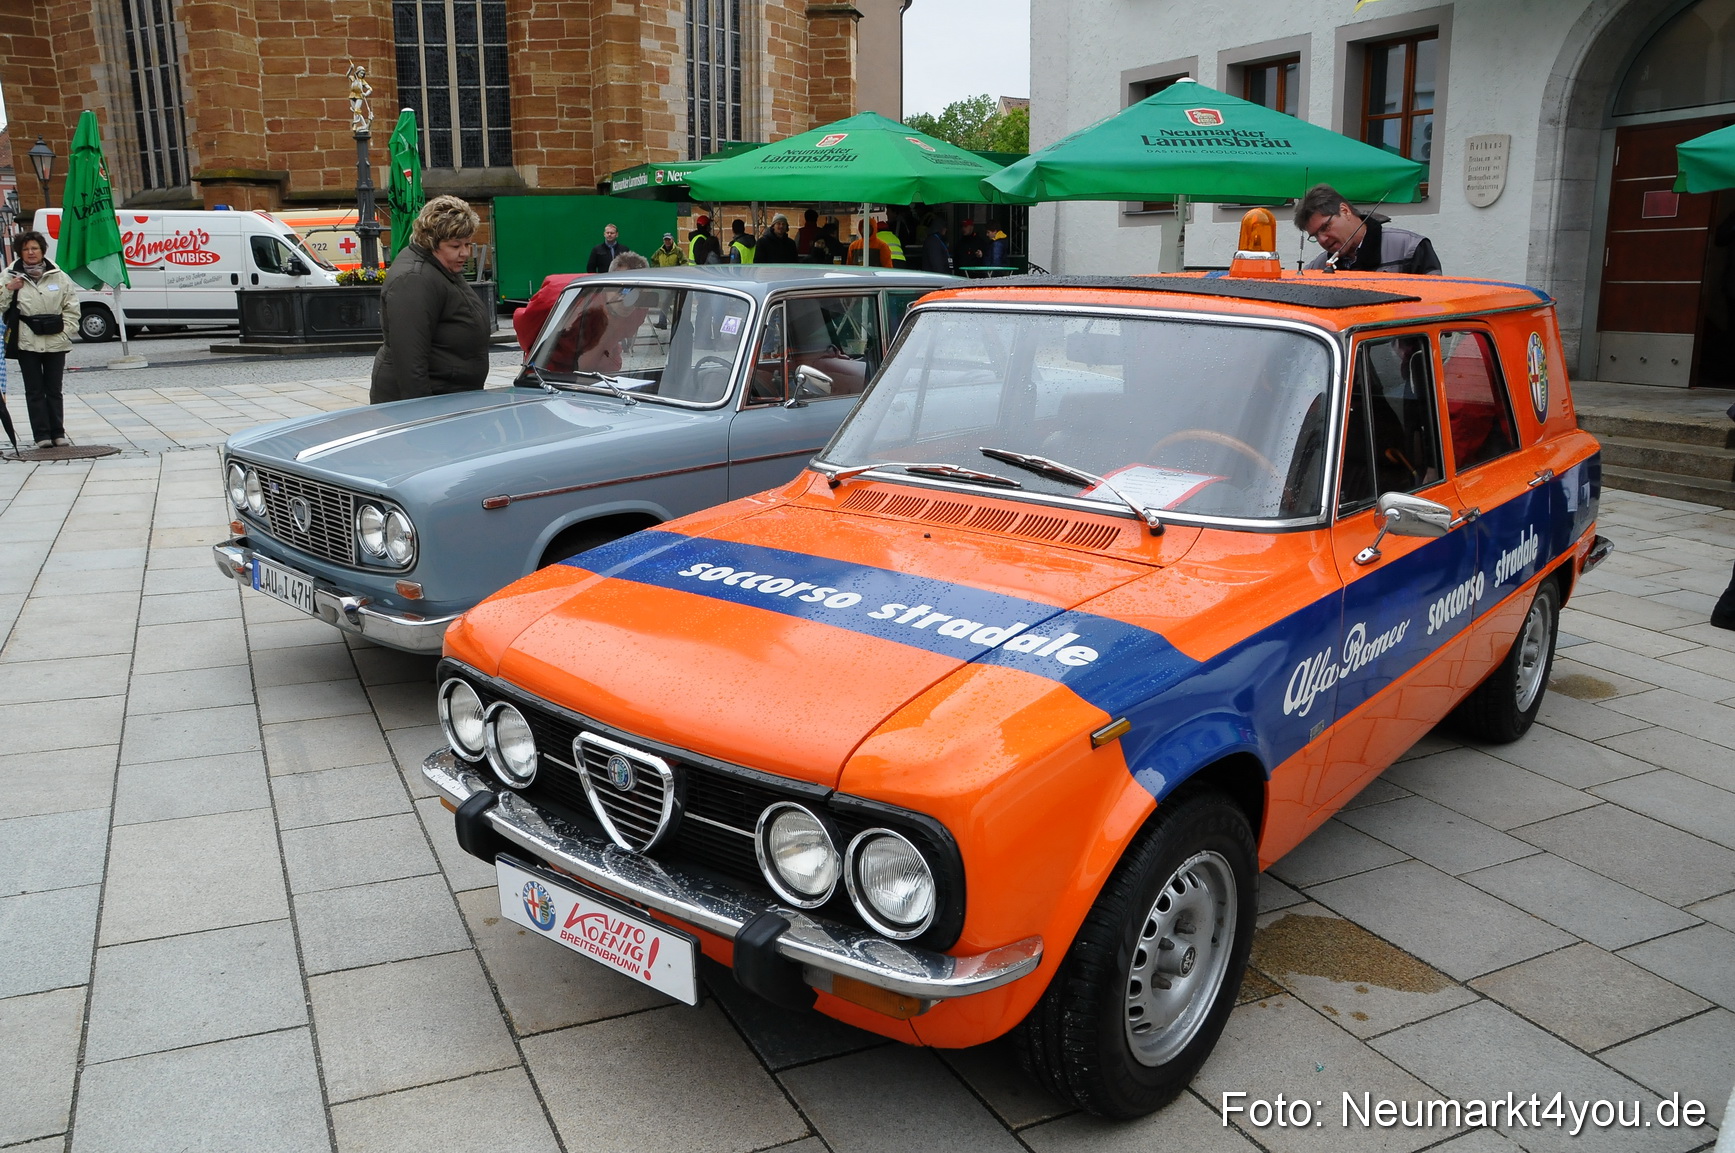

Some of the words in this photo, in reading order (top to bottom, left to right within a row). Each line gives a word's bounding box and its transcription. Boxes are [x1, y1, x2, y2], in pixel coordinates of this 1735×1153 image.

[1140, 135, 1292, 148] Lammsbräu
[1159, 128, 1265, 138] Neumarkter
[760, 153, 859, 164] Lammsbräu
[782, 147, 854, 156] Neumarkter
[172, 252, 214, 263] IMBISS
[259, 564, 278, 595] LAU
[678, 562, 863, 609] soccorso
[867, 601, 1099, 667] stradale
[1283, 646, 1341, 717] Alfa
[1339, 618, 1411, 679] Romeo
[1427, 570, 1485, 635] soccorso
[1494, 523, 1539, 588] stradale
[594, 912, 646, 944] AUTO
[560, 929, 640, 975] BREITENBRUNN
